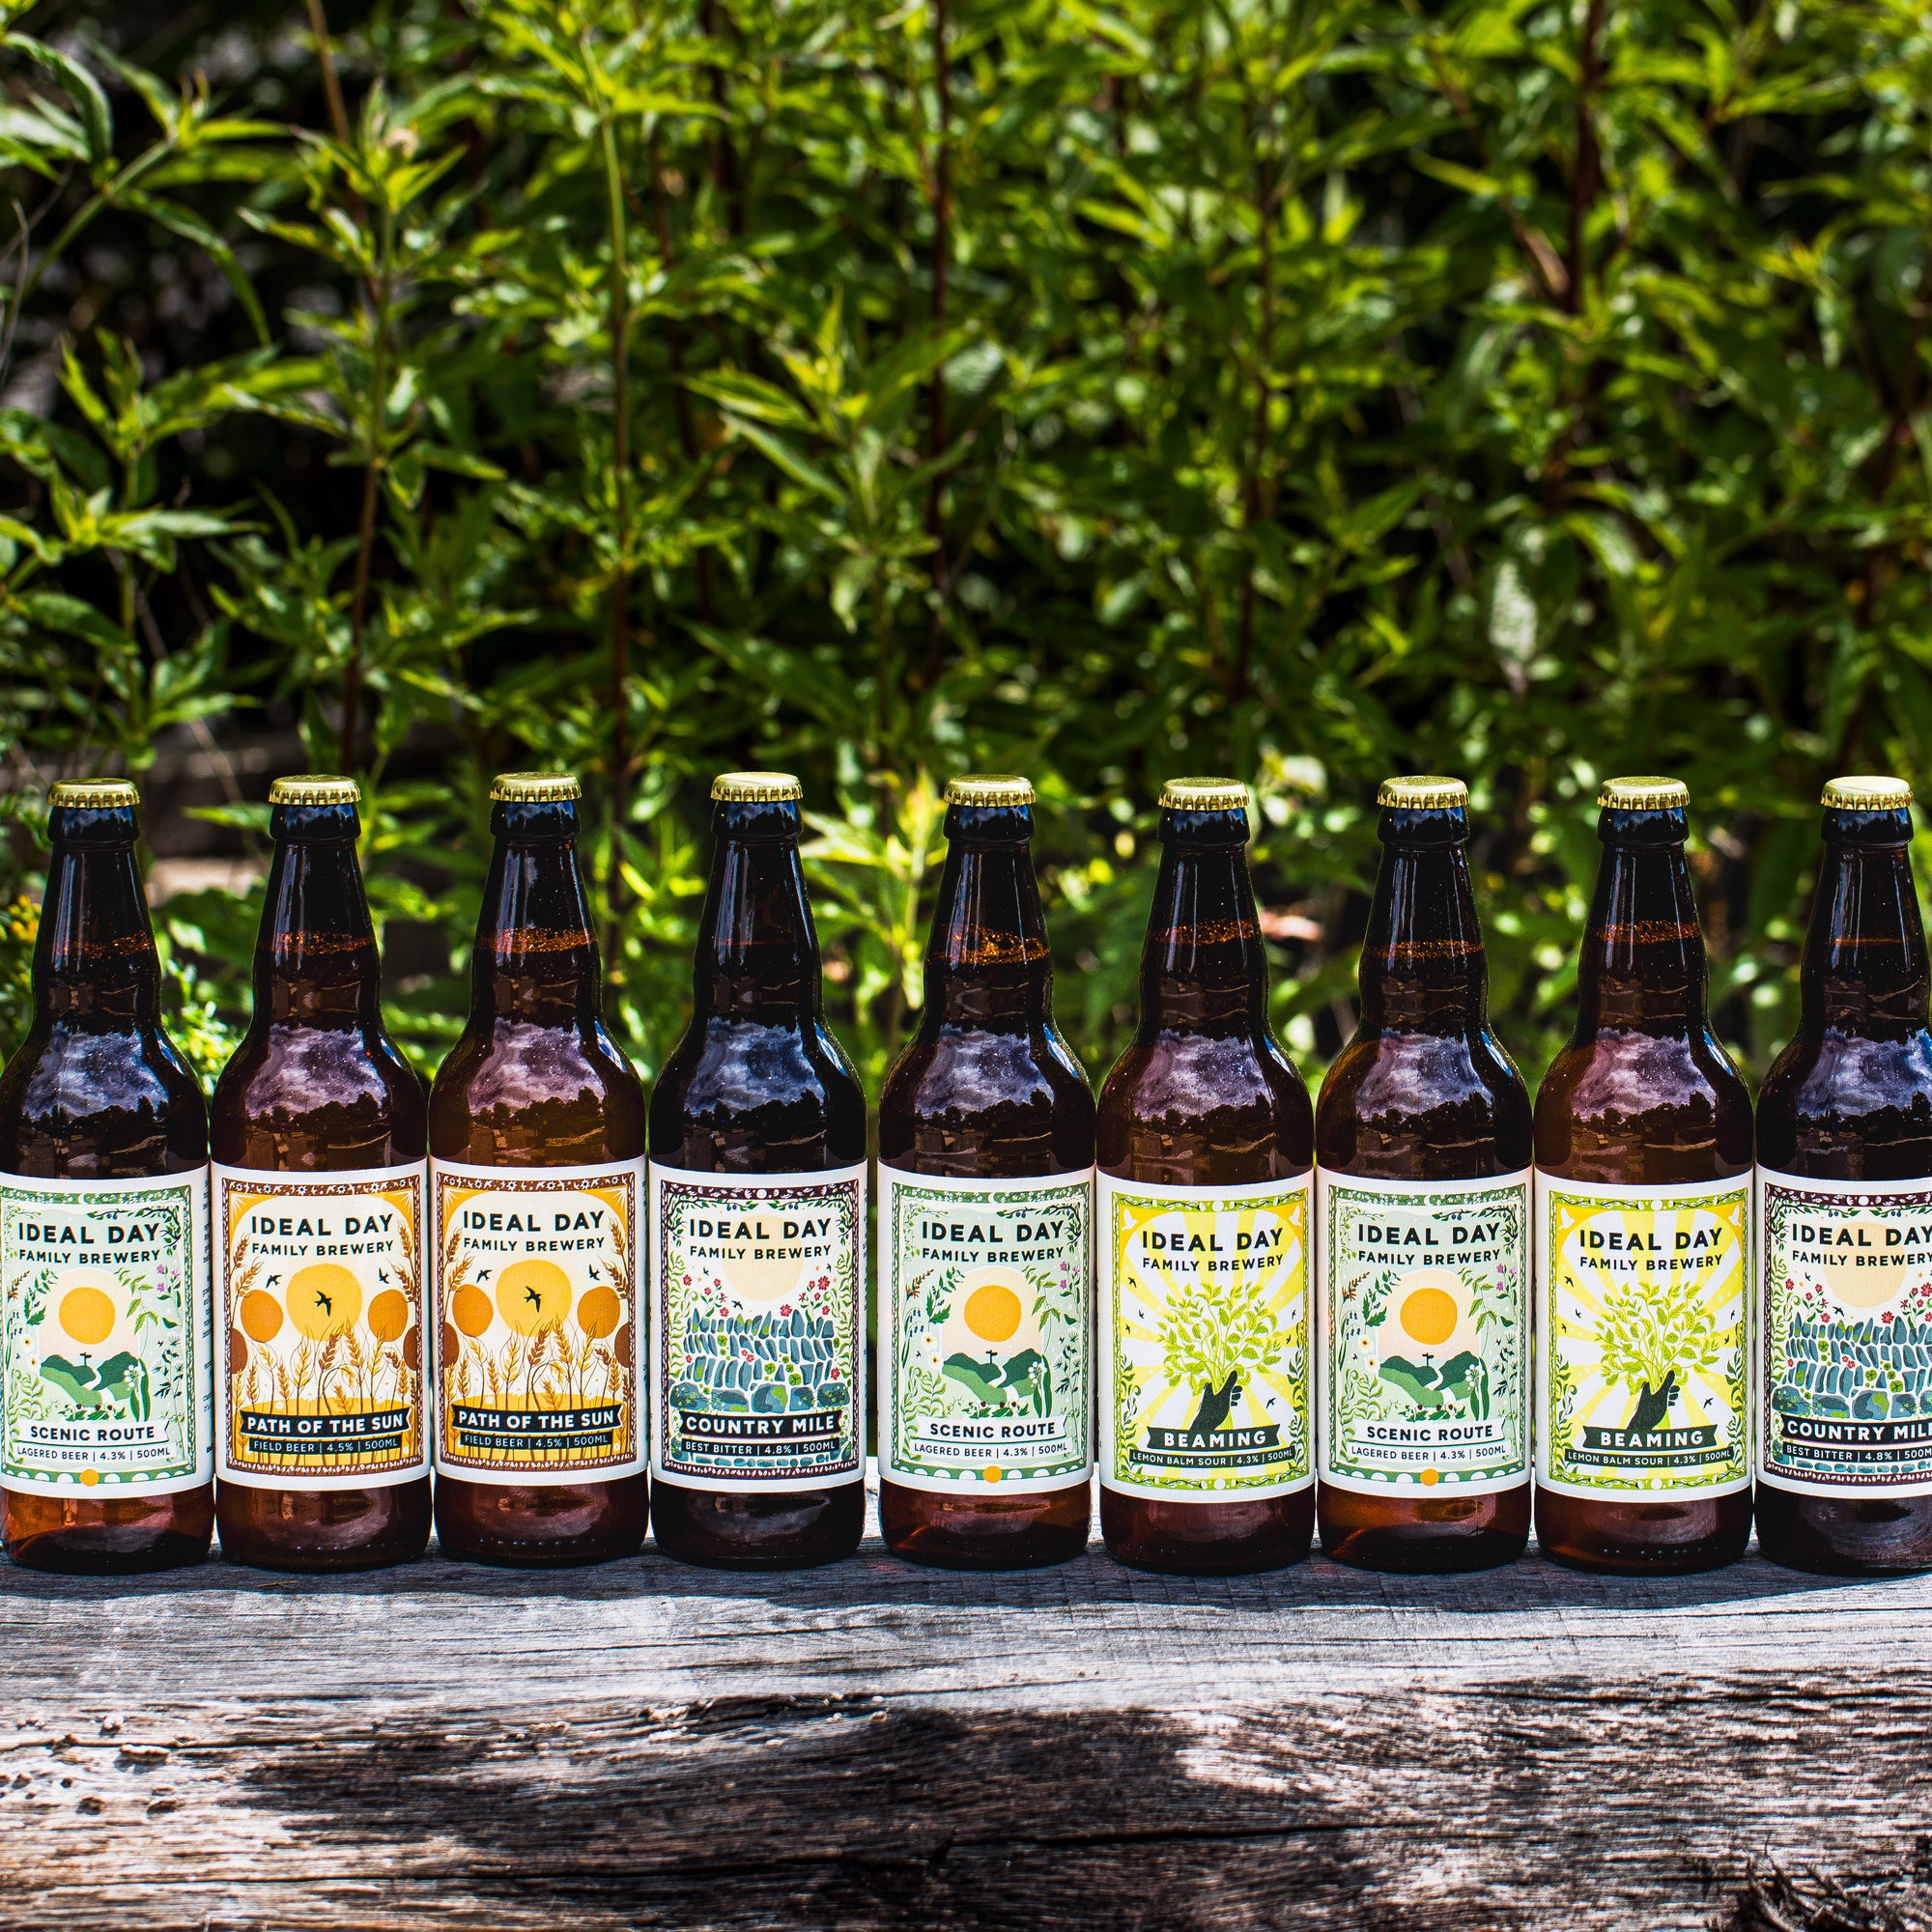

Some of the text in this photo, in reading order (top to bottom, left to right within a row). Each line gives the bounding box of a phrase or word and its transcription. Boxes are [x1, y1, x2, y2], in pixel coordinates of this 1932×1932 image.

[252, 1214, 393, 1236] IDEAL DAY
[464, 1210, 604, 1232] IDEAL DAY
[690, 1218, 831, 1239] IDEAL DAY
[18, 1222, 159, 1244] IDEAL DAY
[923, 1220, 1064, 1242] IDEAL DAY
[1358, 1223, 1500, 1245] IDEAL DAY
[1793, 1224, 1932, 1246] IDEAL DAY
[465, 1237, 604, 1251] FAMILY BREWERY
[1143, 1228, 1283, 1251] IDEAL DAY
[1580, 1228, 1722, 1251] IDEAL DAY
[252, 1240, 393, 1256] FAMILY BREWERY
[691, 1245, 831, 1259] FAMILY BREWERY
[923, 1247, 1064, 1263] FAMILY BREWERY
[19, 1249, 159, 1264] FAMILY BREWERY
[1143, 1255, 1283, 1271] FAMILY BREWERY
[1358, 1249, 1500, 1264] FAMILY BREWERY
[1580, 1255, 1722, 1270] FAMILY BREWERY
[1793, 1250, 1932, 1266] FAMILY BREWERY
[247, 1413, 403, 1434] PATH OF THE SUN
[459, 1410, 613, 1429] PATH OF THE SUN
[686, 1415, 835, 1435] COUNTRY MILE
[31, 1426, 155, 1441] SCENIC ROUTE
[930, 1422, 1055, 1438] SCENIC ROUTE
[1367, 1425, 1492, 1441] SCENIC ROUTE
[1787, 1421, 1886, 1441] COUNTRY
[254, 1440, 282, 1451] FIELD
[287, 1443, 314, 1452] BEER
[327, 1442, 354, 1452] 4.5%
[365, 1439, 398, 1449] 500ML
[465, 1435, 491, 1445] FIELD
[496, 1438, 524, 1447] BEER
[536, 1438, 562, 1447] 4.5%
[575, 1435, 608, 1445] 500ML
[686, 1441, 709, 1452] BEST
[714, 1444, 752, 1454] BITTER
[764, 1444, 792, 1454] 4.8%
[803, 1440, 835, 1452] 500ML
[1164, 1431, 1266, 1448] BEAMING
[1600, 1432, 1704, 1447] BEAMING
[17, 1447, 57, 1459] LAGERED
[62, 1450, 88, 1460] BEER
[100, 1450, 126, 1460] 4.3%
[137, 1446, 170, 1458] 500ML
[914, 1443, 959, 1456] LAGERED
[965, 1448, 991, 1457] BEER
[1003, 1448, 1028, 1457] 4.3%
[1038, 1444, 1066, 1454] 500ML
[1132, 1453, 1163, 1463] LEMON
[1236, 1454, 1259, 1463] 4.3%
[1267, 1450, 1293, 1462] 500ML
[1351, 1446, 1396, 1459] LAGERED
[1402, 1451, 1429, 1460] BEER
[1439, 1450, 1465, 1460] 4.3%
[1475, 1446, 1506, 1457] 500ML
[1568, 1451, 1599, 1463] LEMON
[1603, 1456, 1631, 1464] BALM
[1674, 1454, 1696, 1463] 4.3%
[1705, 1450, 1731, 1462] 500ML
[1787, 1445, 1809, 1456] BEST
[1814, 1450, 1852, 1460] BITTER
[1865, 1451, 1892, 1461] 4.8%
[1904, 1448, 1932, 1459] 500M
